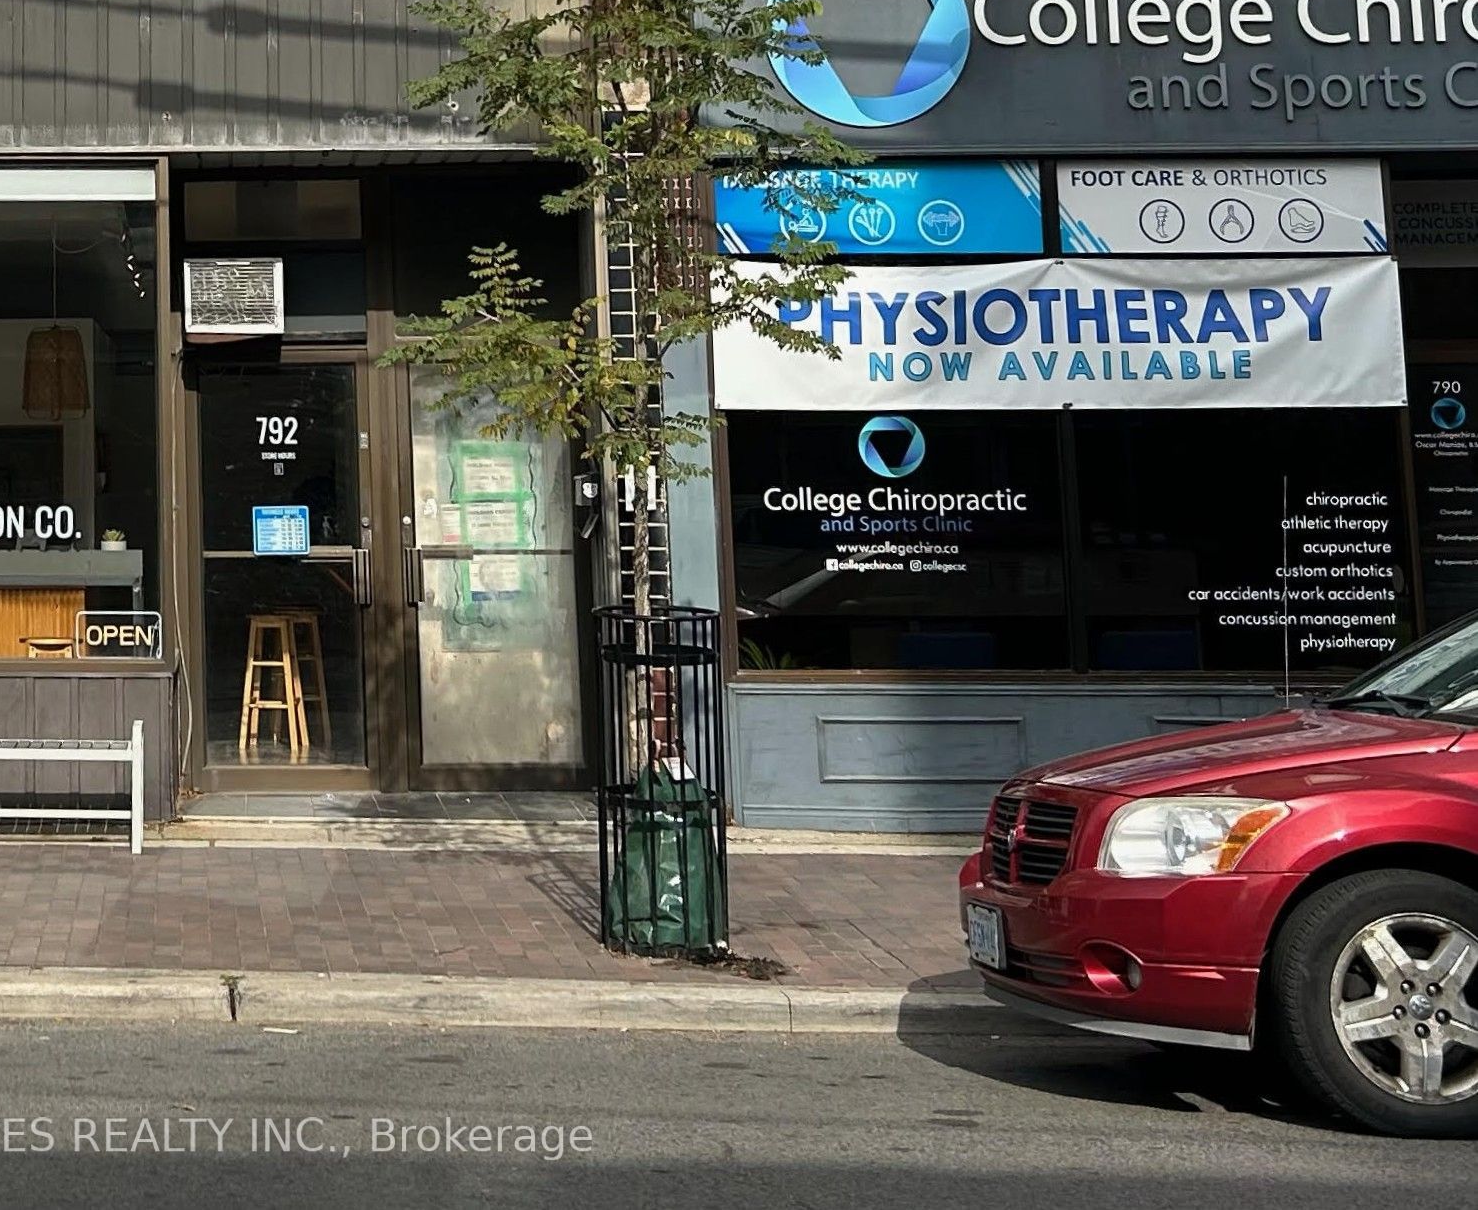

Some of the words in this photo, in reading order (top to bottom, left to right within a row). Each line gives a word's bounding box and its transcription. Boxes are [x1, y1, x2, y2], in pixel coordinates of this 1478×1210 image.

[1127, 63, 1228, 109] and
[1249, 63, 1426, 121] Sports
[1071, 170, 1124, 186] FOOT
[1131, 170, 1183, 186] CARE
[1193, 170, 1207, 186] &
[1215, 169, 1327, 186] ORTHOTICS
[777, 286, 1333, 347] PHYSIOTHERAPY
[869, 352, 972, 382] NOW
[999, 350, 1251, 381] AVAILABLE
[1432, 380, 1461, 394] 790
[256, 416, 298, 445] 792
[763, 487, 861, 516] College
[868, 487, 1027, 516] Chiropractic
[1306, 491, 1388, 508] chiropractic
[34, 505, 82, 539] CO.
[820, 515, 854, 532] and
[859, 515, 917, 535] Sports
[923, 515, 972, 532] Clinic
[1281, 515, 1331, 530] athletic
[1334, 515, 1389, 533] therapy
[836, 541, 959, 556] www.collegechiro.ca
[1303, 541, 1392, 556] acupuncture
[1275, 565, 1327, 577] custom
[1330, 563, 1393, 577] orthotics
[1188, 589, 1210, 601] car
[1328, 586, 1395, 601] accidents
[1219, 611, 1297, 625] concussion
[1300, 612, 1396, 628] management
[86, 625, 152, 646] OPEN
[1300, 633, 1397, 652] physiotherapy
